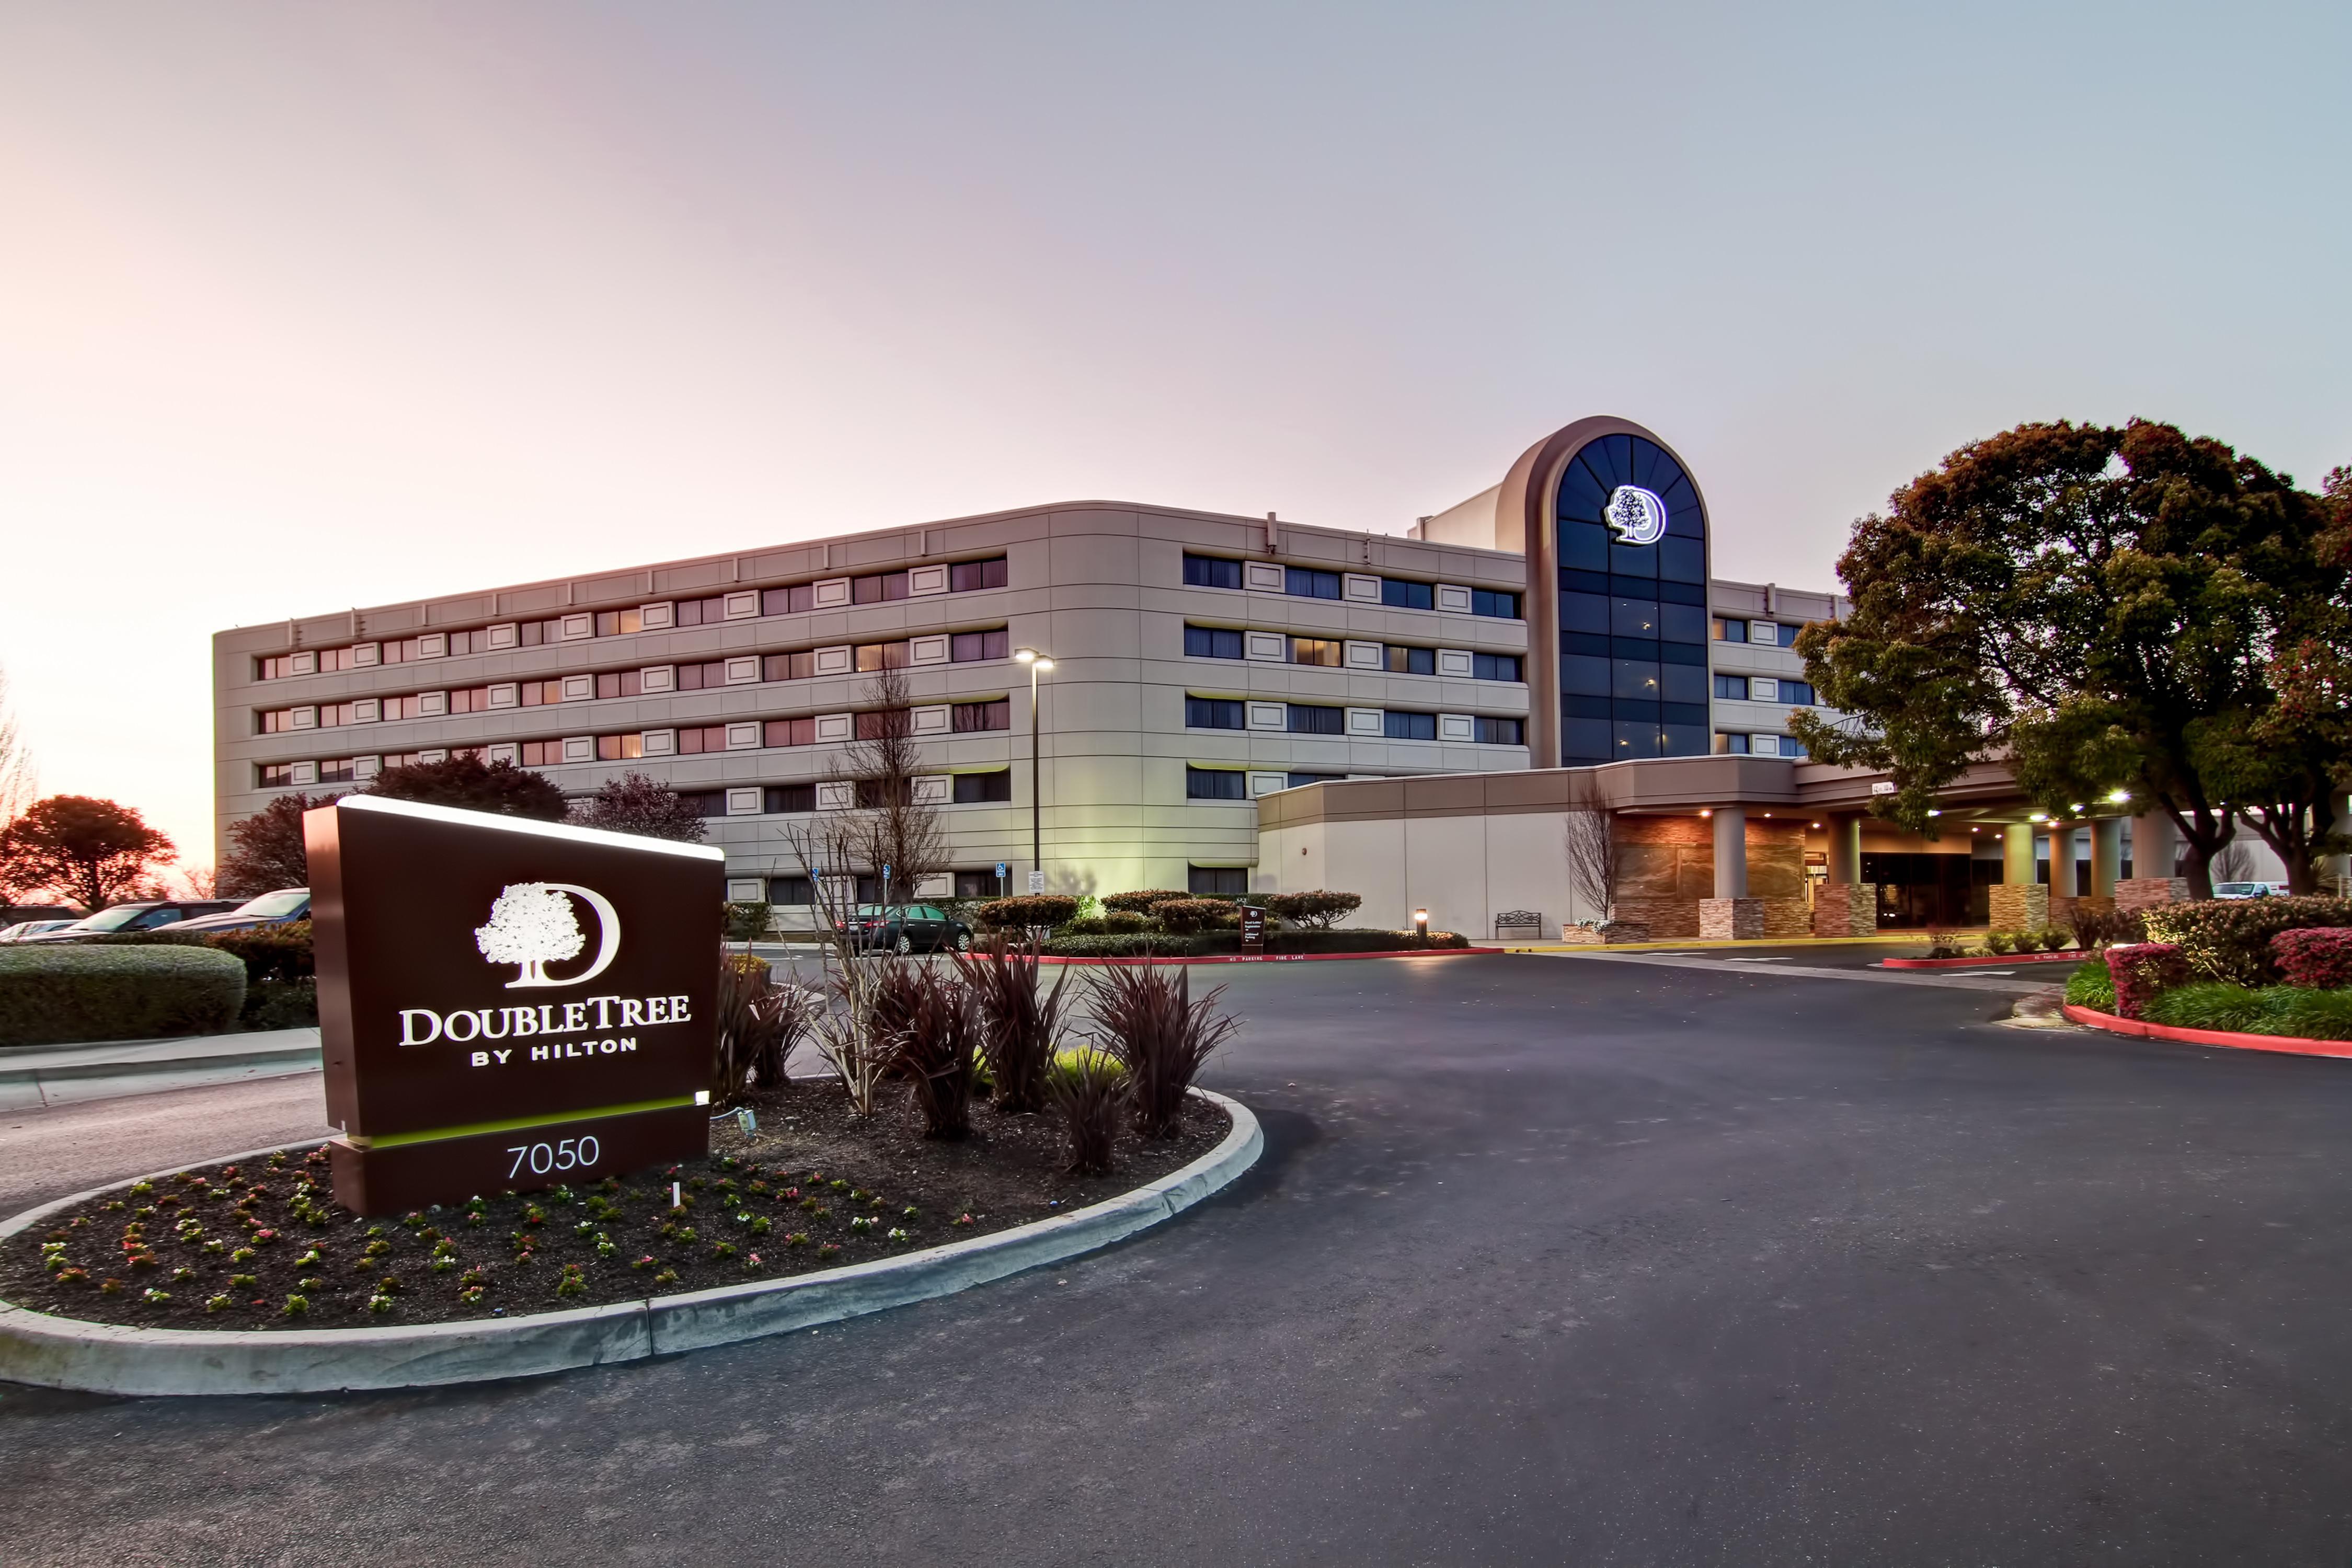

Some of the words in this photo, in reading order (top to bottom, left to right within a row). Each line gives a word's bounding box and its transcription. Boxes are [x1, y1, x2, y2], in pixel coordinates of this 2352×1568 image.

[399, 995, 692, 1047] DOUBLETREE
[472, 1049, 513, 1067] BY
[532, 1037, 637, 1061] HILTON
[507, 1135, 600, 1179] 7050
